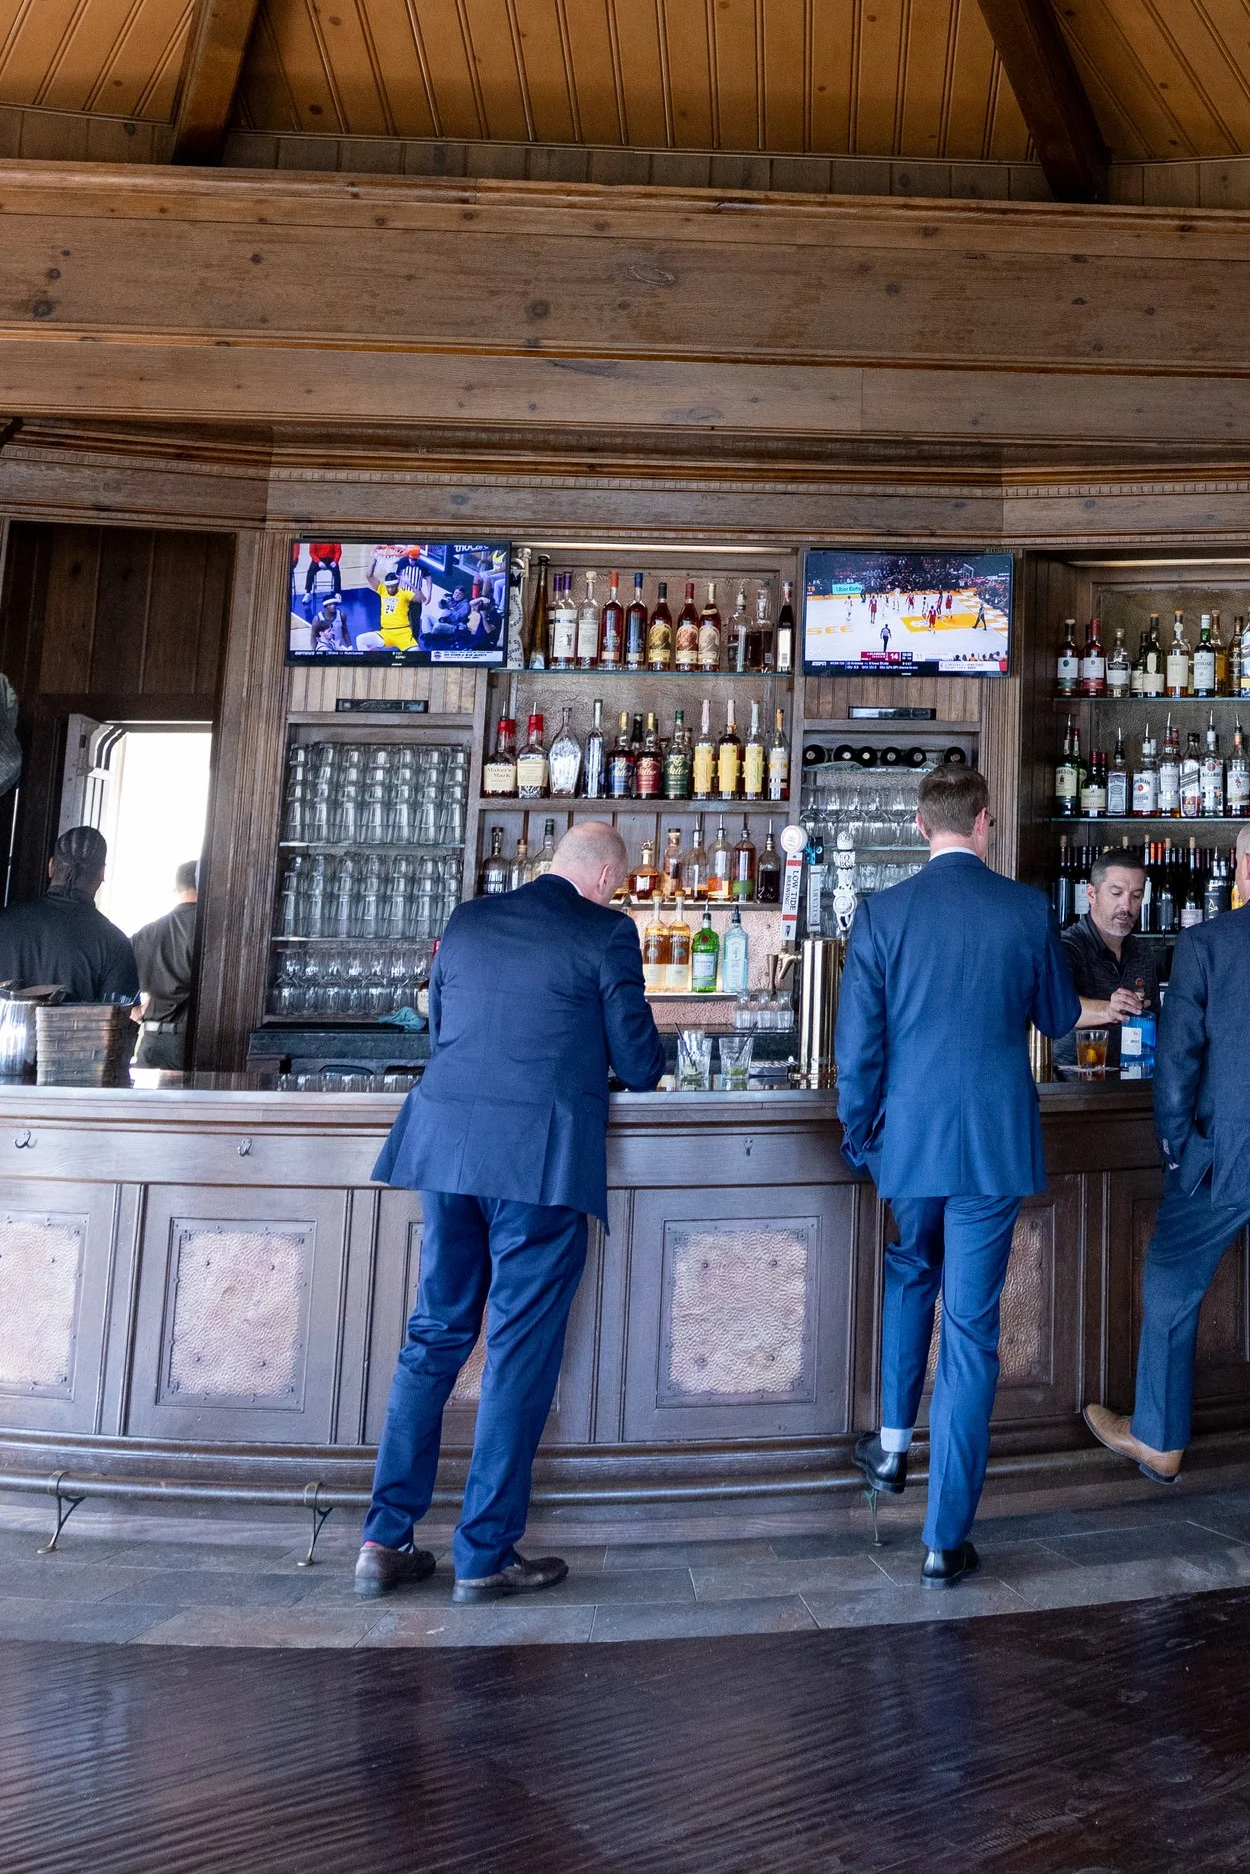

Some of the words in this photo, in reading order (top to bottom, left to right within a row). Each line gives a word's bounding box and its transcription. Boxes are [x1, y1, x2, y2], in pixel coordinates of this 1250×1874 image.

[791, 870, 800, 890] LOW
[784, 875, 792, 906] BREWING
[789, 892, 799, 911] TIDE
